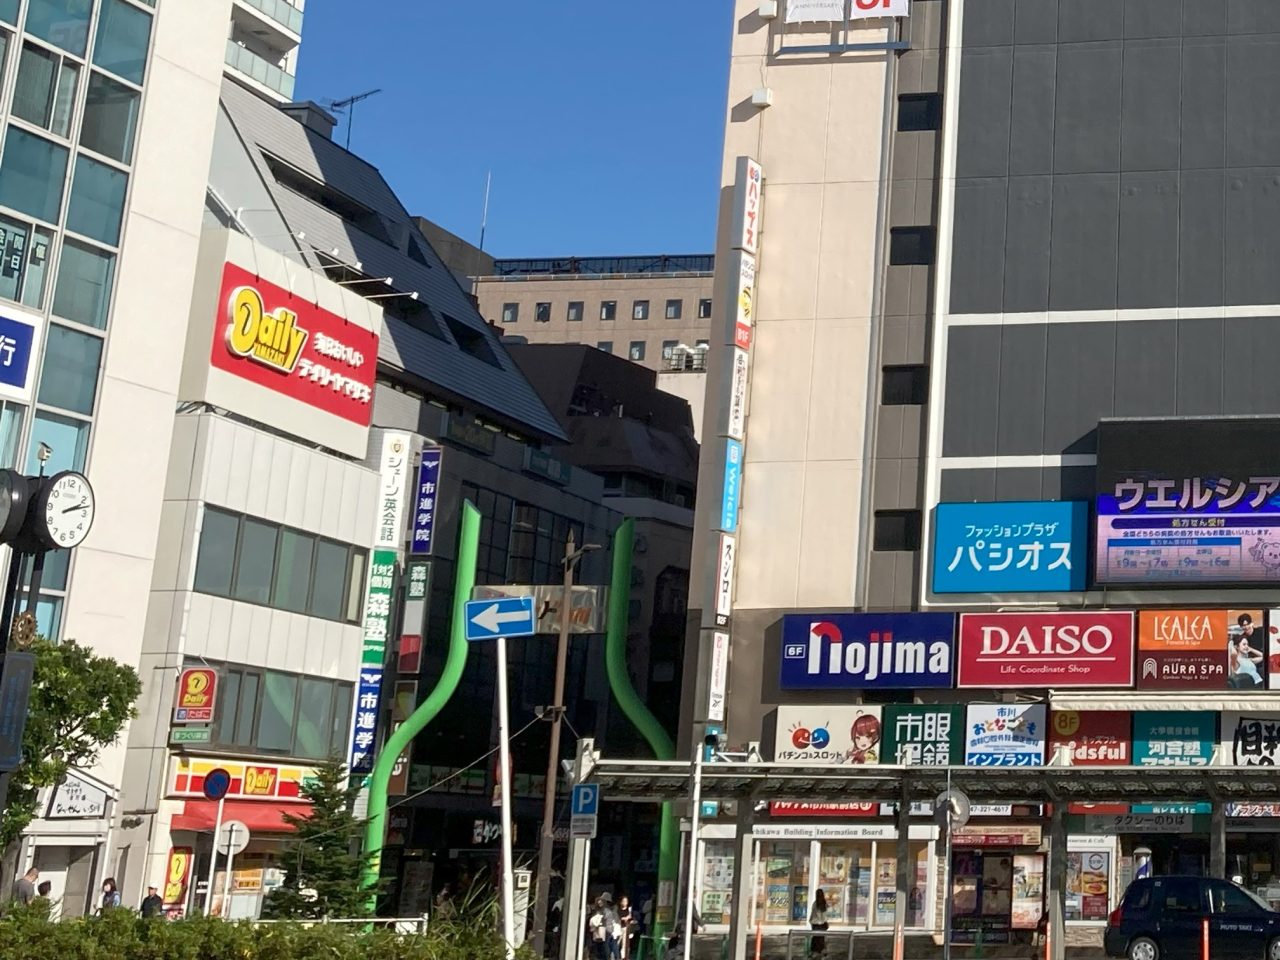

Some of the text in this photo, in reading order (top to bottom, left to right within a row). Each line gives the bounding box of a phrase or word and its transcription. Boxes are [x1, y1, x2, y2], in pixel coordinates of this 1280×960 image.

[233, 289, 306, 370] Daily
[381, 457, 402, 541] シェーン英会話
[1115, 476, 1280, 511] ウエルシア
[416, 482, 434, 541] 市進学院
[965, 522, 1059, 538] ファッションプラザ
[947, 540, 1072, 572] パシオス
[722, 544, 731, 609] スシロー
[980, 625, 1113, 655] DAISO
[1154, 616, 1213, 640] LEALEA
[808, 621, 950, 681] nojima
[1000, 664, 1090, 674] Life Coordinate Shop
[1201, 664, 1223, 674] SPA
[997, 707, 1016, 717] 市川
[1058, 714, 1078, 729] 8F
[1149, 741, 1200, 755] 河合塾
[578, 788, 593, 812] P
[784, 828, 813, 837] Building
[816, 828, 858, 836] Information
[862, 828, 883, 836] Board
[1115, 815, 1185, 826] タクシーのりば
